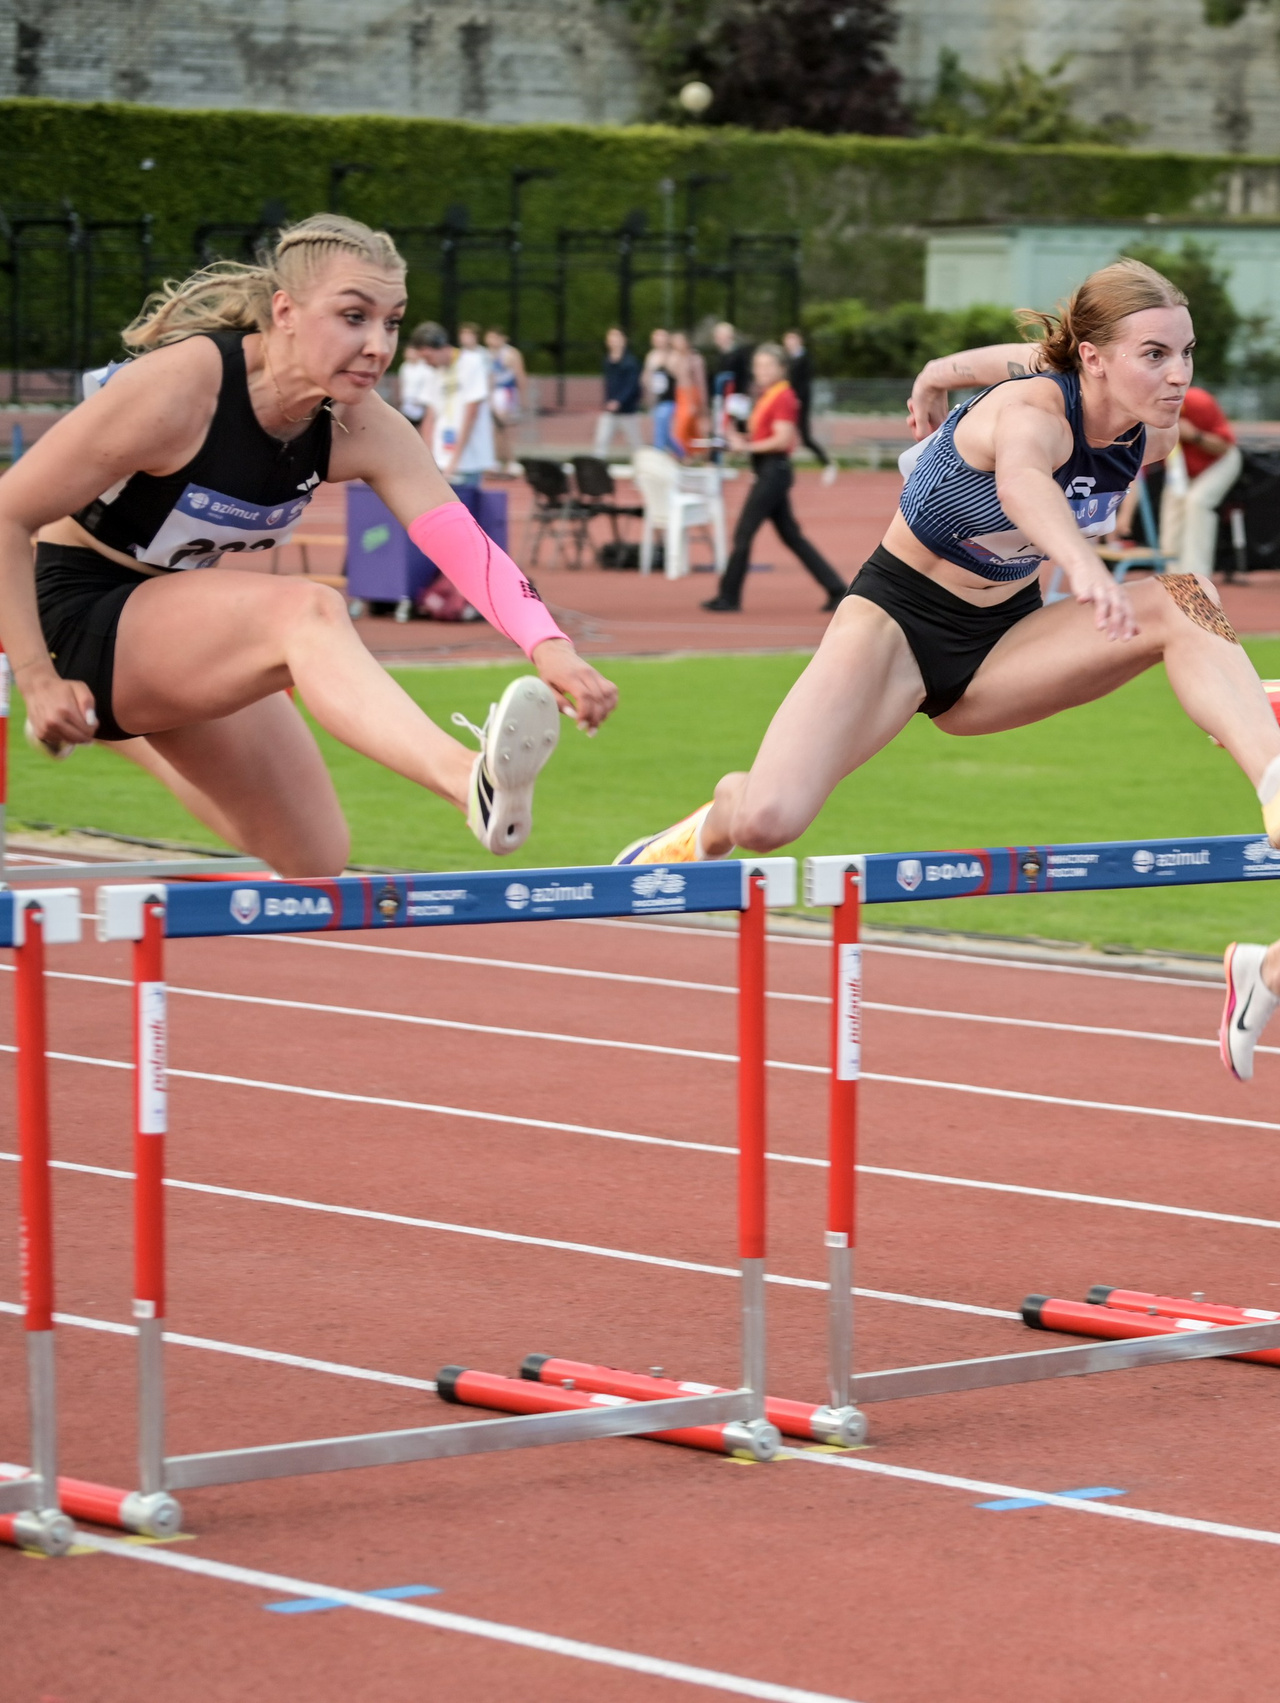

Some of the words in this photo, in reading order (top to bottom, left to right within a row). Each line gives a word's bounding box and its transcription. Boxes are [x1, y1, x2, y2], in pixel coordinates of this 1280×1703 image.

[210, 501, 260, 521] azimut
[1155, 849, 1211, 867] azimut
[925, 862, 984, 881] ВФЛА
[531, 882, 594, 902] azimut
[264, 897, 333, 916] ВФЛА
[846, 977, 861, 1044] polanik
[148, 1018, 167, 1092] polanik
